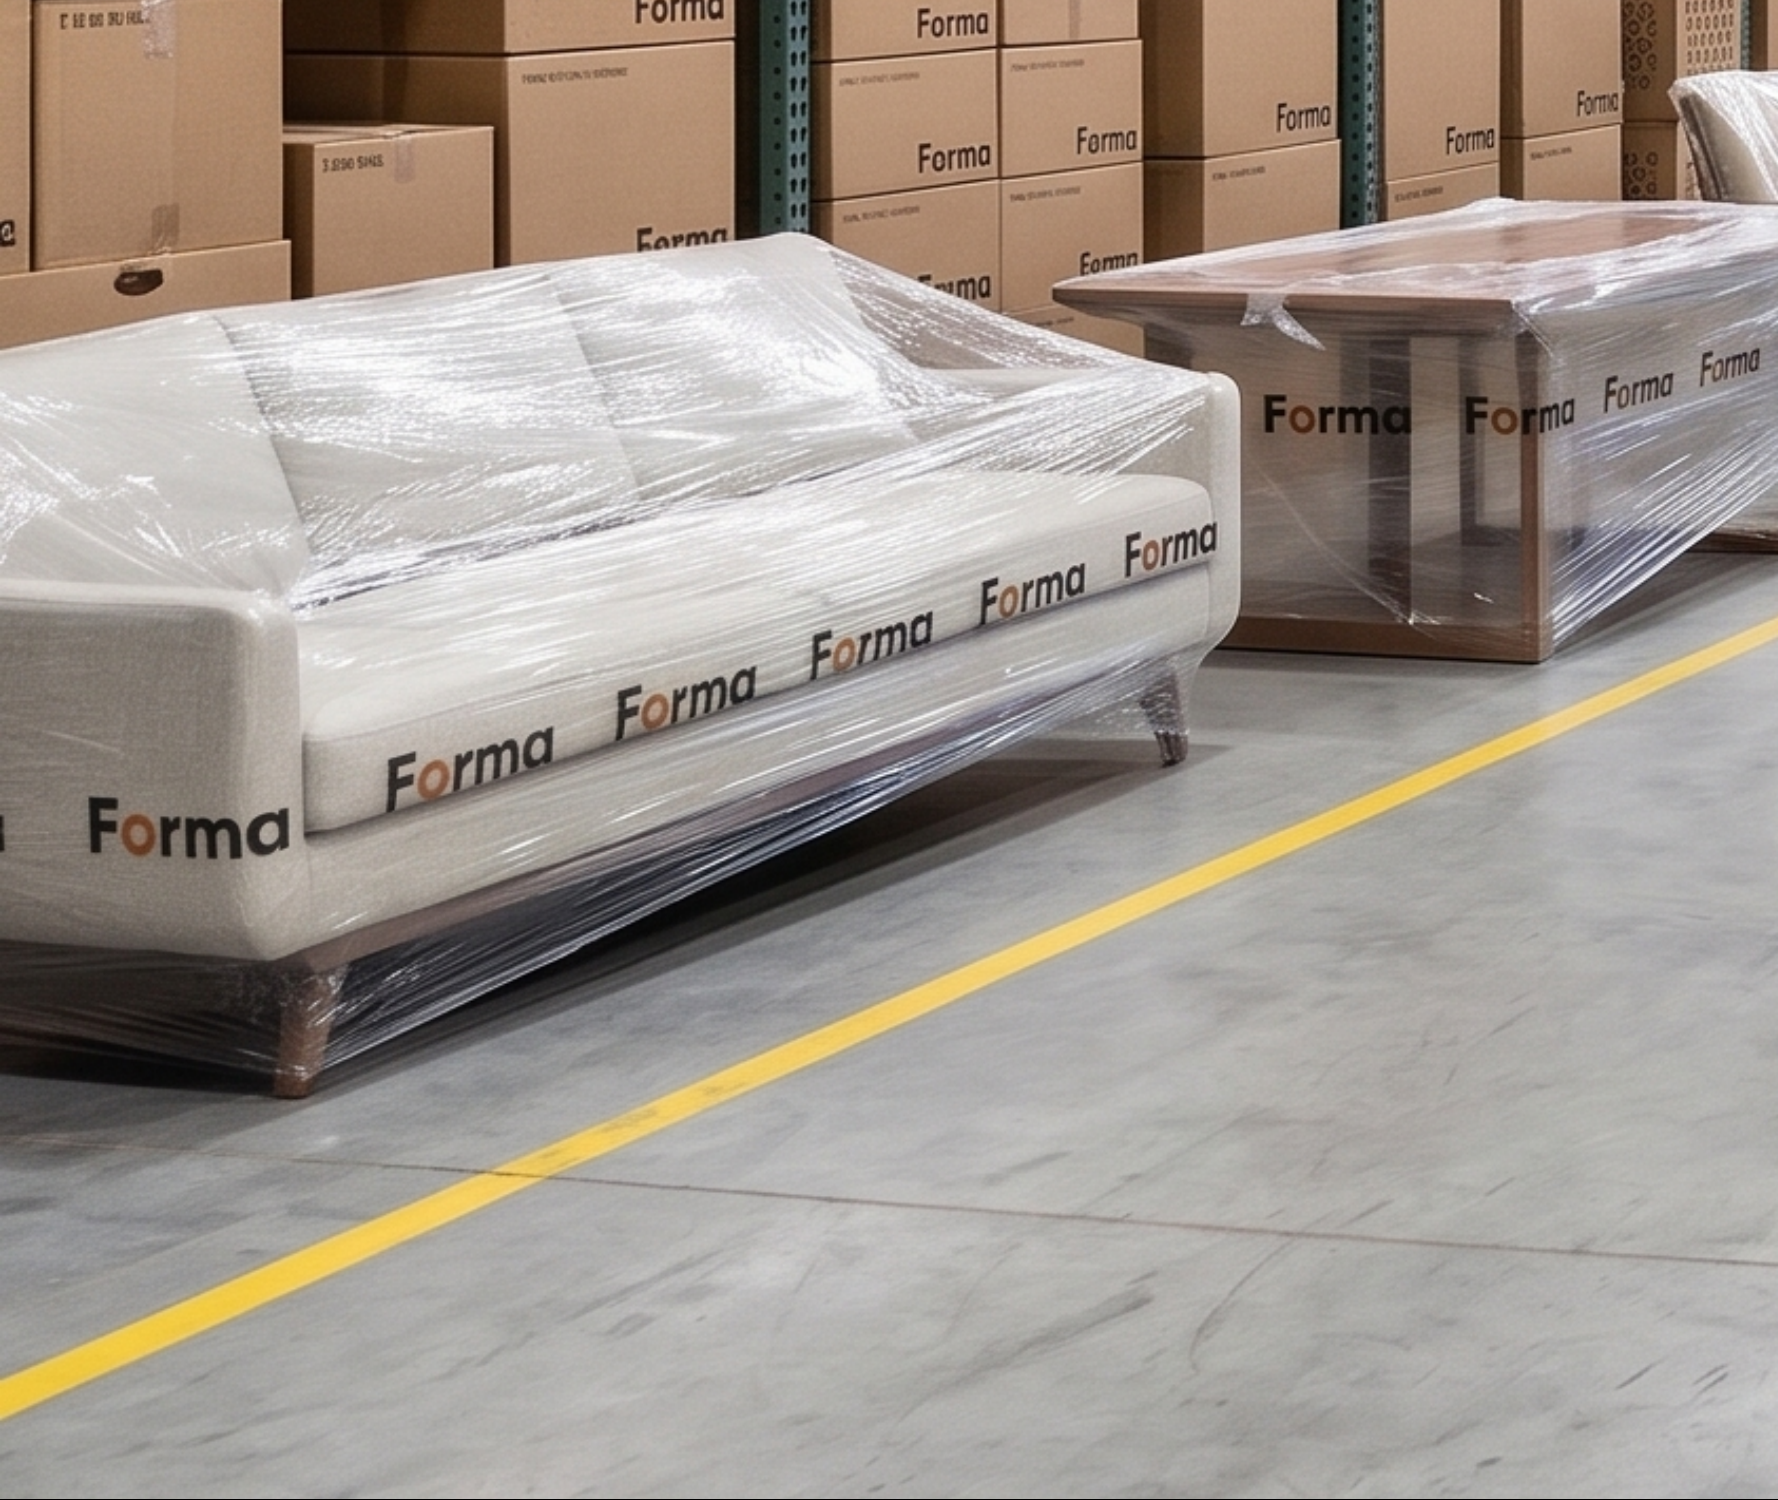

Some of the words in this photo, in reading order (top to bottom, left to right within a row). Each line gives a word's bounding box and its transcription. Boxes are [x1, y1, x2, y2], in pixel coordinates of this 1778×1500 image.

[917, 8, 989, 40] Forma
[1277, 103, 1331, 133] Forma
[1077, 126, 1137, 154] Forma
[1447, 125, 1495, 155] Forma
[918, 143, 991, 173] Forma
[1465, 396, 1575, 436] Forma
[1604, 372, 1672, 413] Forma
[1700, 346, 1760, 386] Forma
[1264, 395, 1411, 434] Forma
[386, 726, 554, 811] Forma
[614, 666, 757, 740] Forma
[811, 609, 932, 680] Forma
[981, 562, 1086, 626] Forma
[1125, 521, 1217, 577] Forma
[89, 797, 289, 859] Forma
